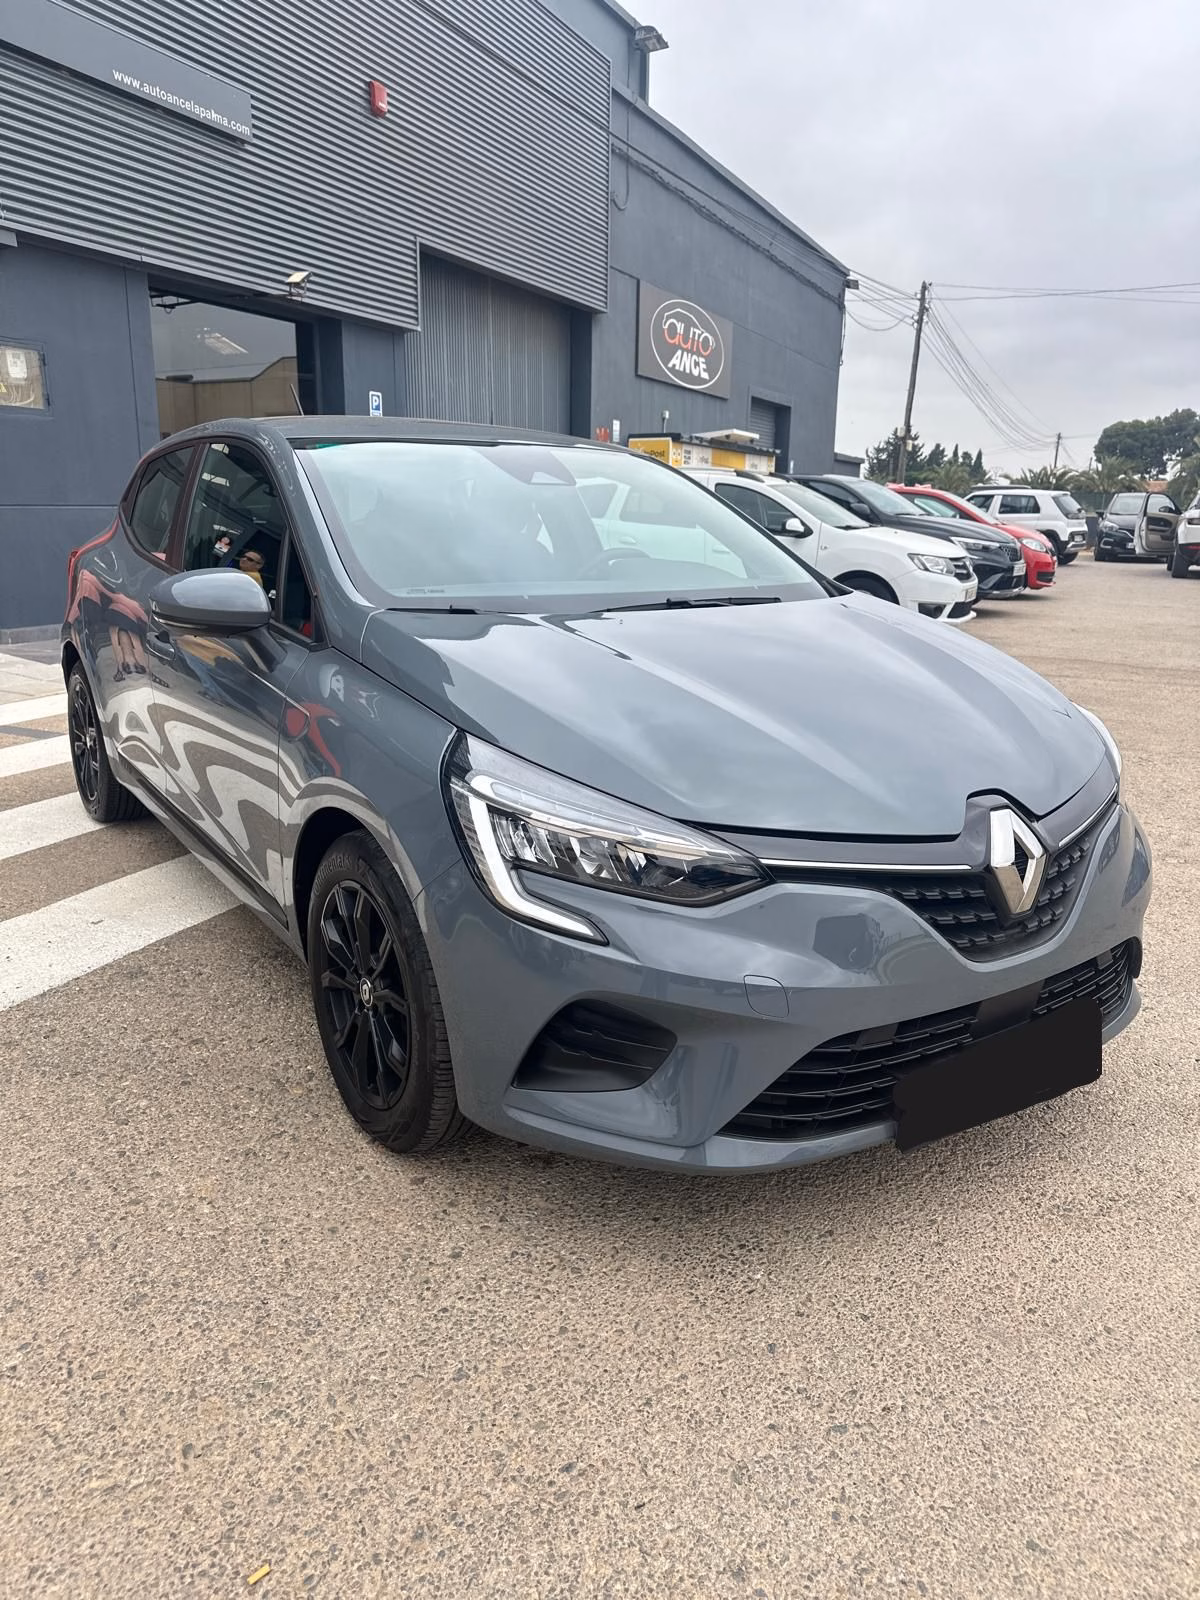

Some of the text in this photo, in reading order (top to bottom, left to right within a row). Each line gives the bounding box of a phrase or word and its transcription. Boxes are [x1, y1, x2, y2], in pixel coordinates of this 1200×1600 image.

[112, 69, 250, 136] www.autoancelapalma.com
[667, 349, 710, 380] ANCE
[372, 395, 380, 409] P
